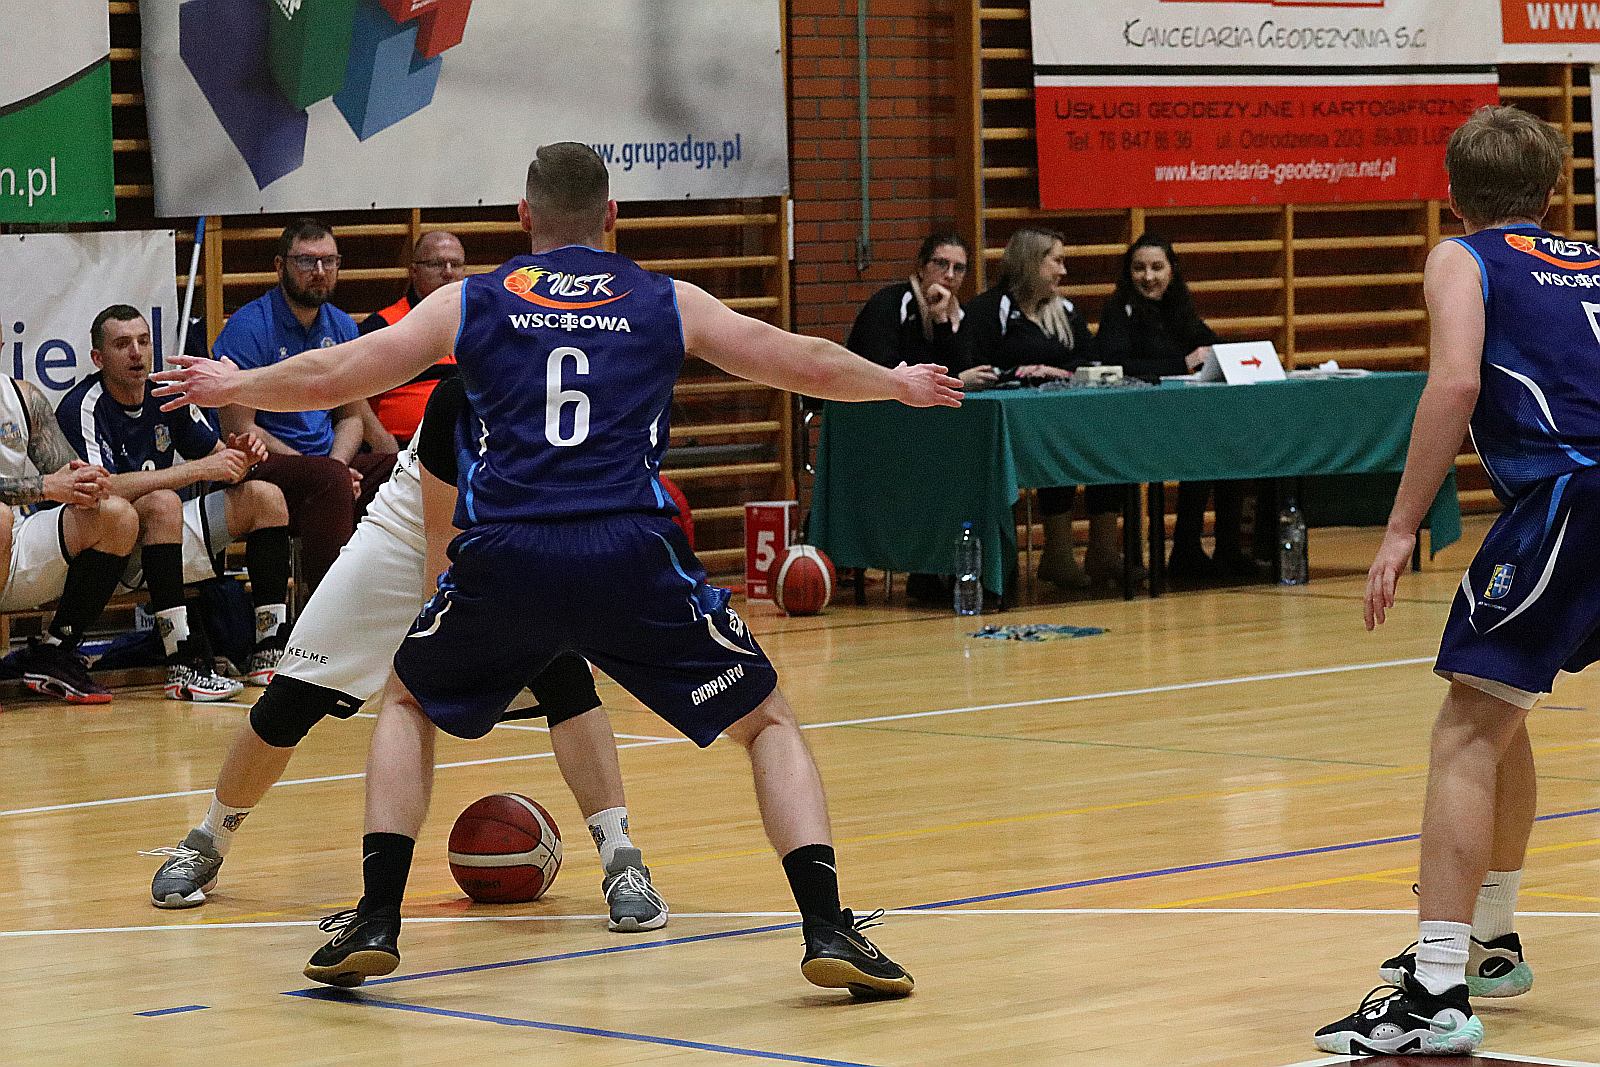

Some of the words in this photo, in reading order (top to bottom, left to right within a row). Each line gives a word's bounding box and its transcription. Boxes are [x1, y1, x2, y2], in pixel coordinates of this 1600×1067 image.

[1148, 100, 1293, 119] GEODEZYJNE
[587, 133, 742, 171] w.grupadgp.pl
[547, 271, 617, 297] WSK
[544, 346, 591, 447] 6
[755, 530, 776, 573] 5
[288, 646, 329, 665] KELME
